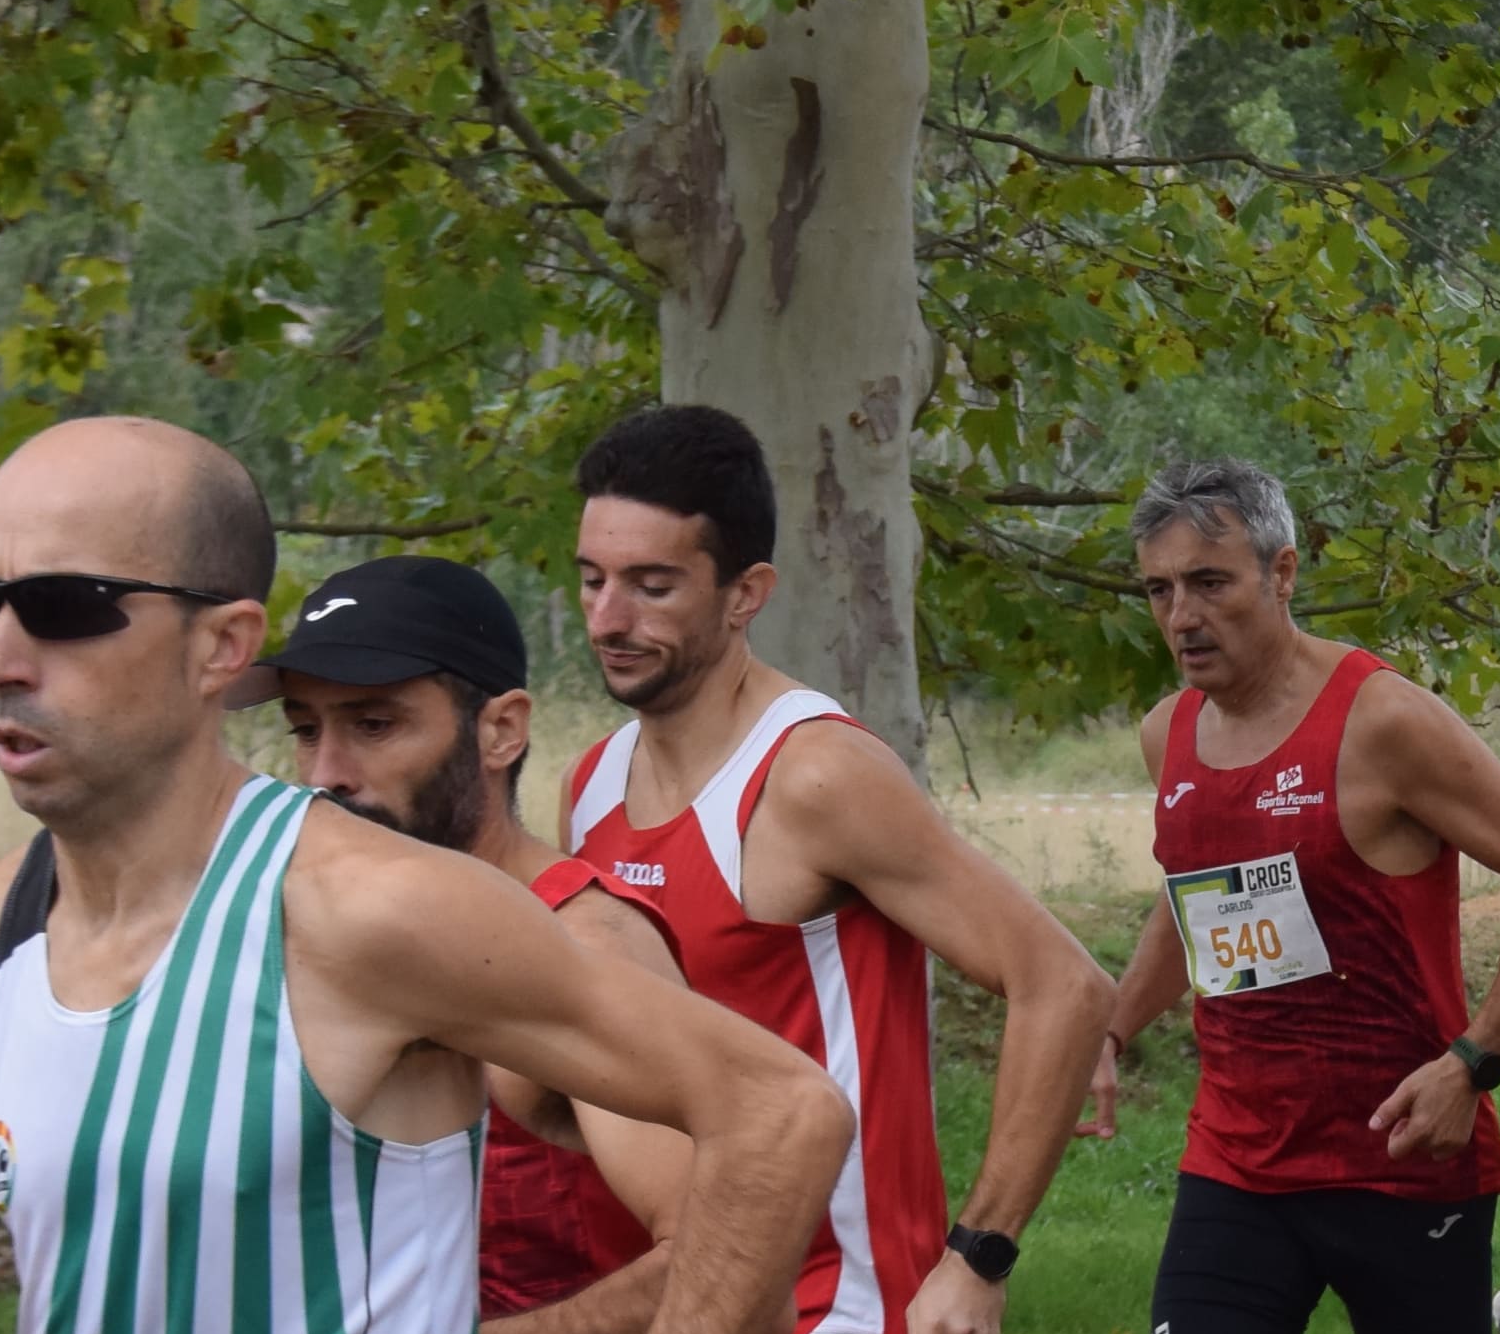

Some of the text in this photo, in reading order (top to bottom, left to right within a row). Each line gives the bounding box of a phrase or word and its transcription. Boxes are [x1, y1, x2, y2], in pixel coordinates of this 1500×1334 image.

[1246, 861, 1292, 892] CROS
[1217, 900, 1253, 915] CARLOS
[1210, 919, 1282, 968] 540
